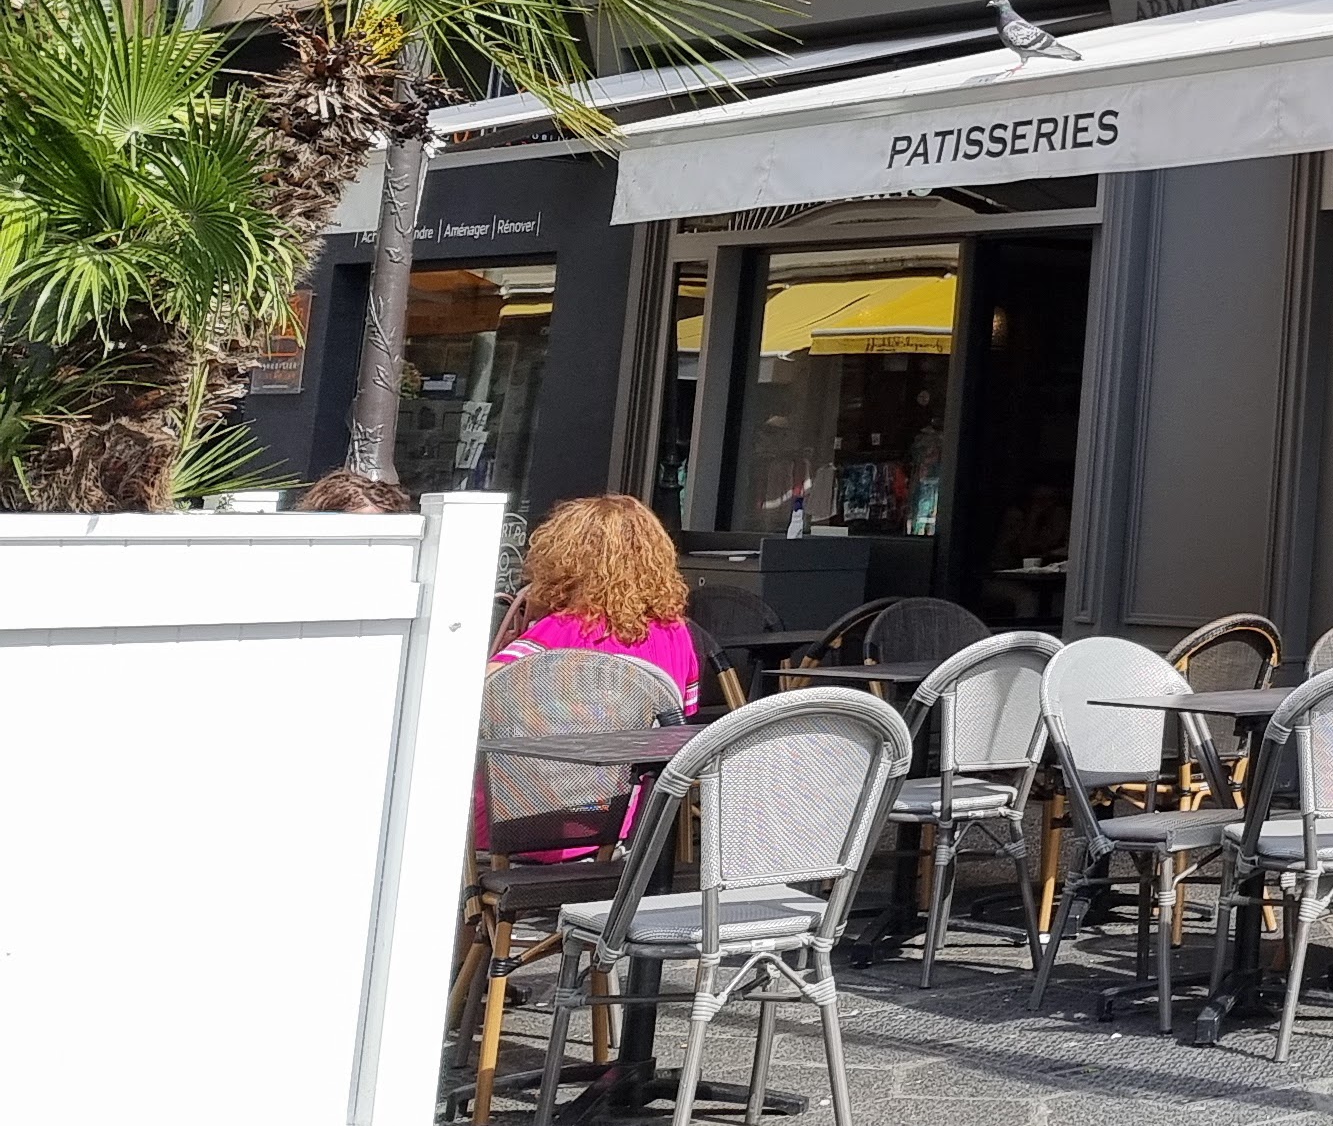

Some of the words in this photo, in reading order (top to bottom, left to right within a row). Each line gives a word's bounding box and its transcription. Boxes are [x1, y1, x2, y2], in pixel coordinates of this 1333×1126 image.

[886, 110, 1119, 169] PATISSERIES
[444, 221, 489, 240] Aménager
[497, 219, 536, 234] Rénover
